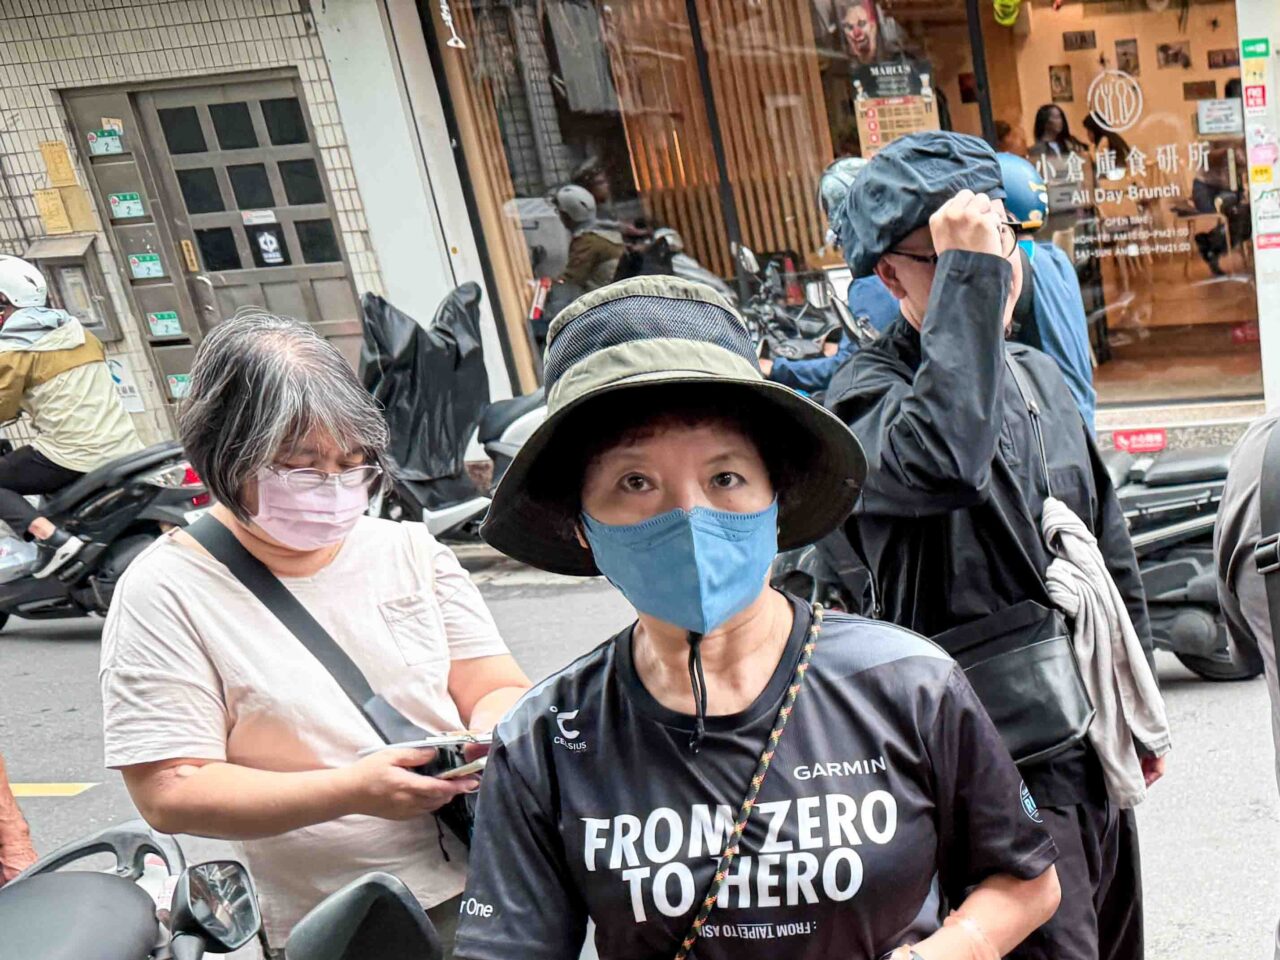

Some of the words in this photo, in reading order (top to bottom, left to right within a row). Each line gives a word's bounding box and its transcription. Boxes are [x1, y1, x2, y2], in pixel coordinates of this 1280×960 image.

[1071, 190, 1090, 204] All
[1095, 188, 1124, 204] Day
[1128, 184, 1181, 201] Brunch
[553, 736, 588, 751] CELSIUS
[793, 756, 887, 781] GARMIN
[581, 803, 740, 872] FROM
[752, 790, 898, 854] ZERO
[622, 861, 696, 923] TO
[711, 847, 864, 910] HERO
[738, 922, 777, 939] TAIPEI
